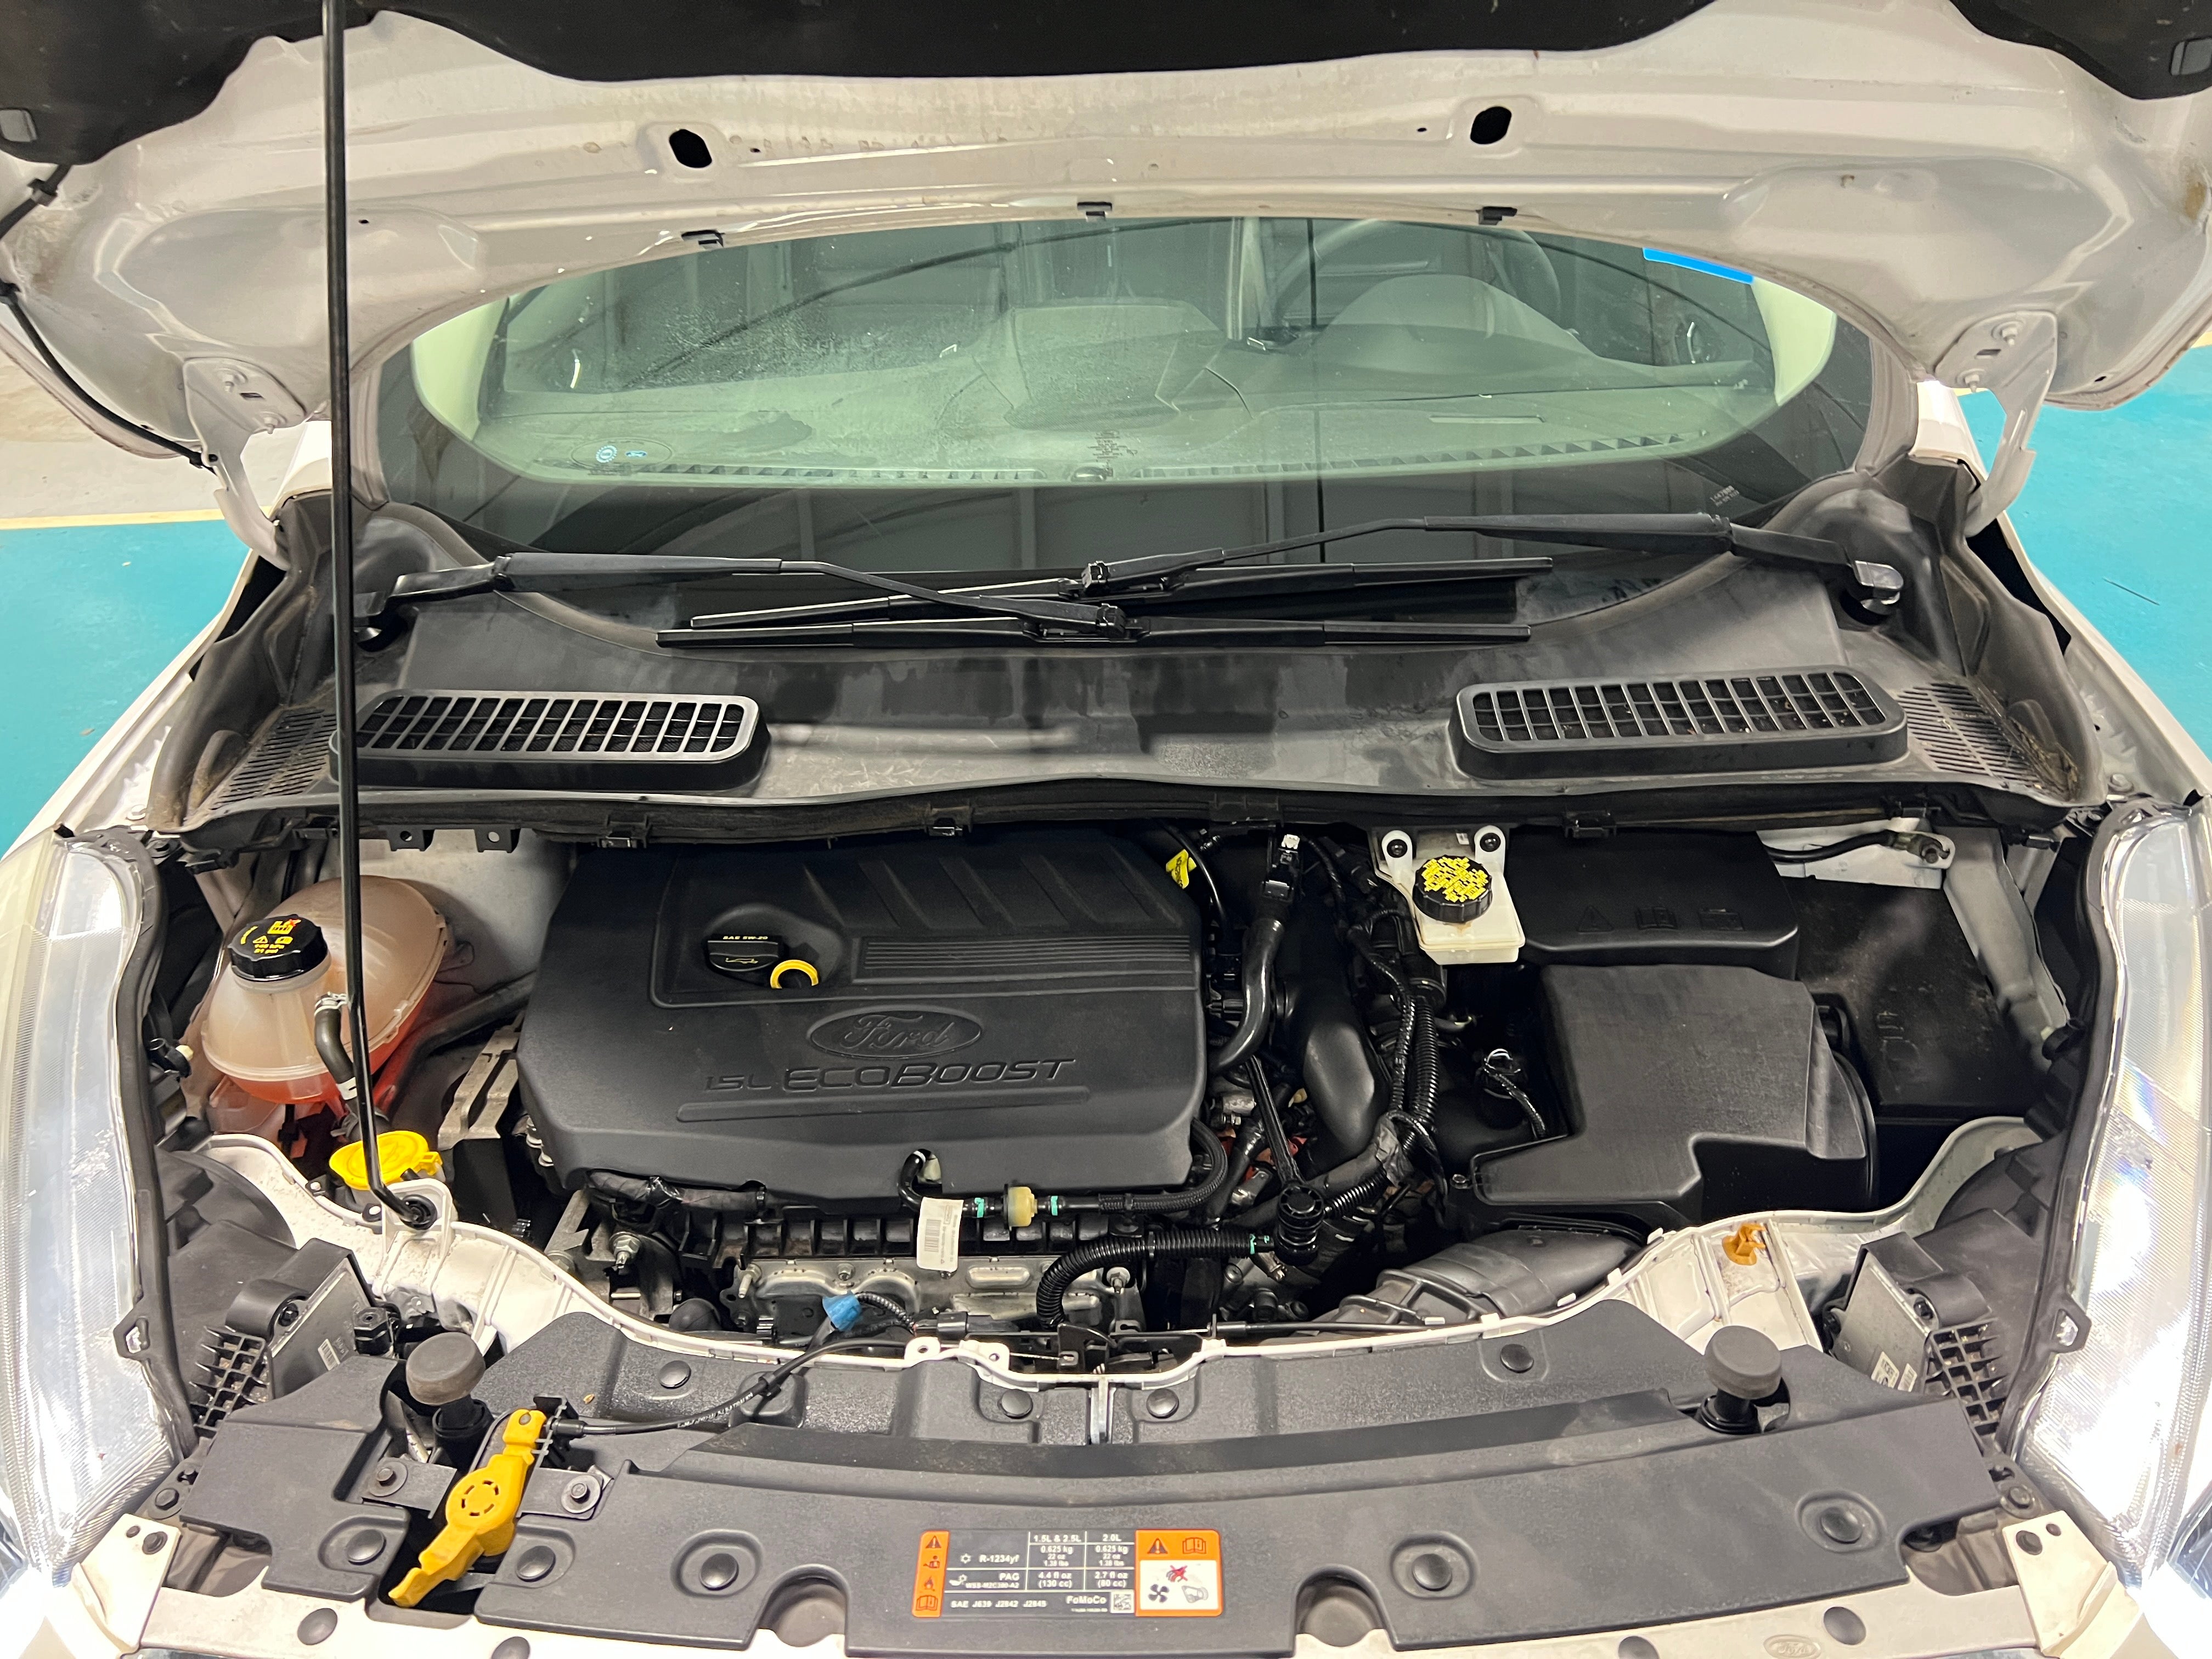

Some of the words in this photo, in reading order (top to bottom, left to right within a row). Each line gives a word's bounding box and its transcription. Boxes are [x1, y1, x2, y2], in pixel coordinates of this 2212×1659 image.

[839, 1014, 956, 1049] Ford
[1034, 1534, 1052, 1543] 1.5L
[1063, 1534, 1081, 1543] 2.5L
[1103, 1533, 1122, 1542] 2.0L
[1040, 1545, 1061, 1553] 0.625
[1063, 1545, 1073, 1555] kg
[1095, 1545, 1116, 1553] 0.625
[1118, 1545, 1129, 1555] kg
[979, 1554, 1019, 1564] R-1234yf
[1000, 1573, 1020, 1581] PAG
[1094, 1571, 1108, 1579] 2.7
[1038, 1580, 1057, 1589] (130
[1058, 1580, 1073, 1589] cc)
[1097, 1580, 1111, 1589] (80
[1112, 1580, 1127, 1589] cc)
[1065, 1595, 1107, 1604] FoMoCo
